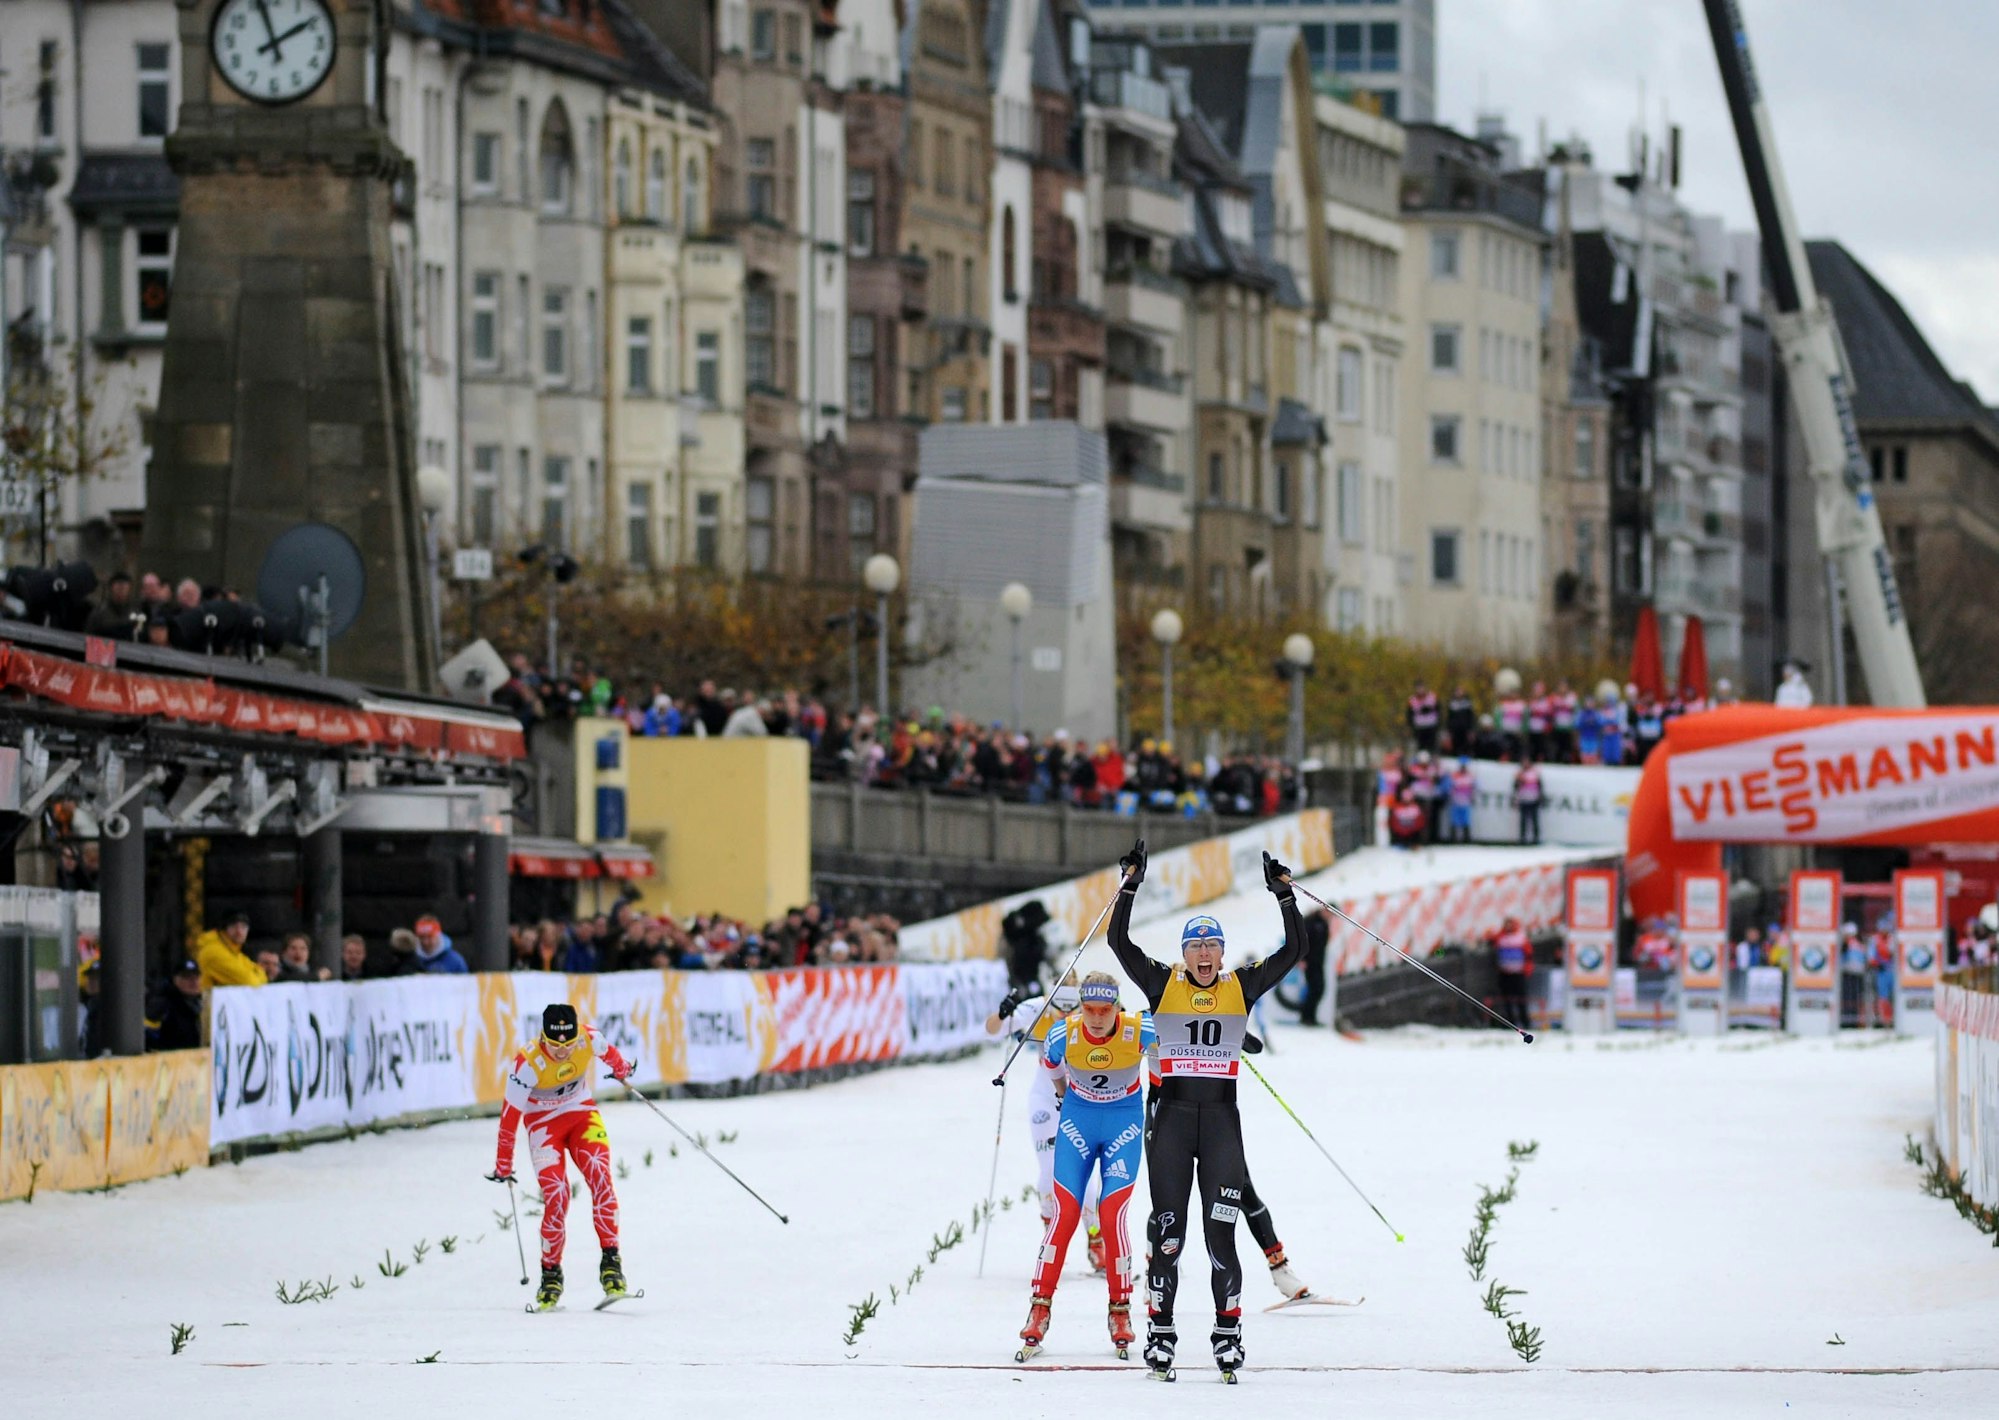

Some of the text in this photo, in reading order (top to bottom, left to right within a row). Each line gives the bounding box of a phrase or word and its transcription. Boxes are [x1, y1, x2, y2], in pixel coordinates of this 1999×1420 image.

[1679, 726, 1997, 834] VIESSMANN
[1194, 997, 1214, 1007] ARAG
[1184, 1019, 1222, 1047] 10
[1090, 1054, 1110, 1063] ARAG
[1170, 1047, 1232, 1058] DÜSSELDORF
[1175, 1060, 1228, 1072] VIESSMANN
[1090, 1074, 1109, 1090] 2
[1059, 1118, 1091, 1161] LUKOIL
[1103, 1122, 1142, 1159] LUKOIL
[1103, 1169, 1130, 1180] adidas
[1038, 1244, 1046, 1260] 2
